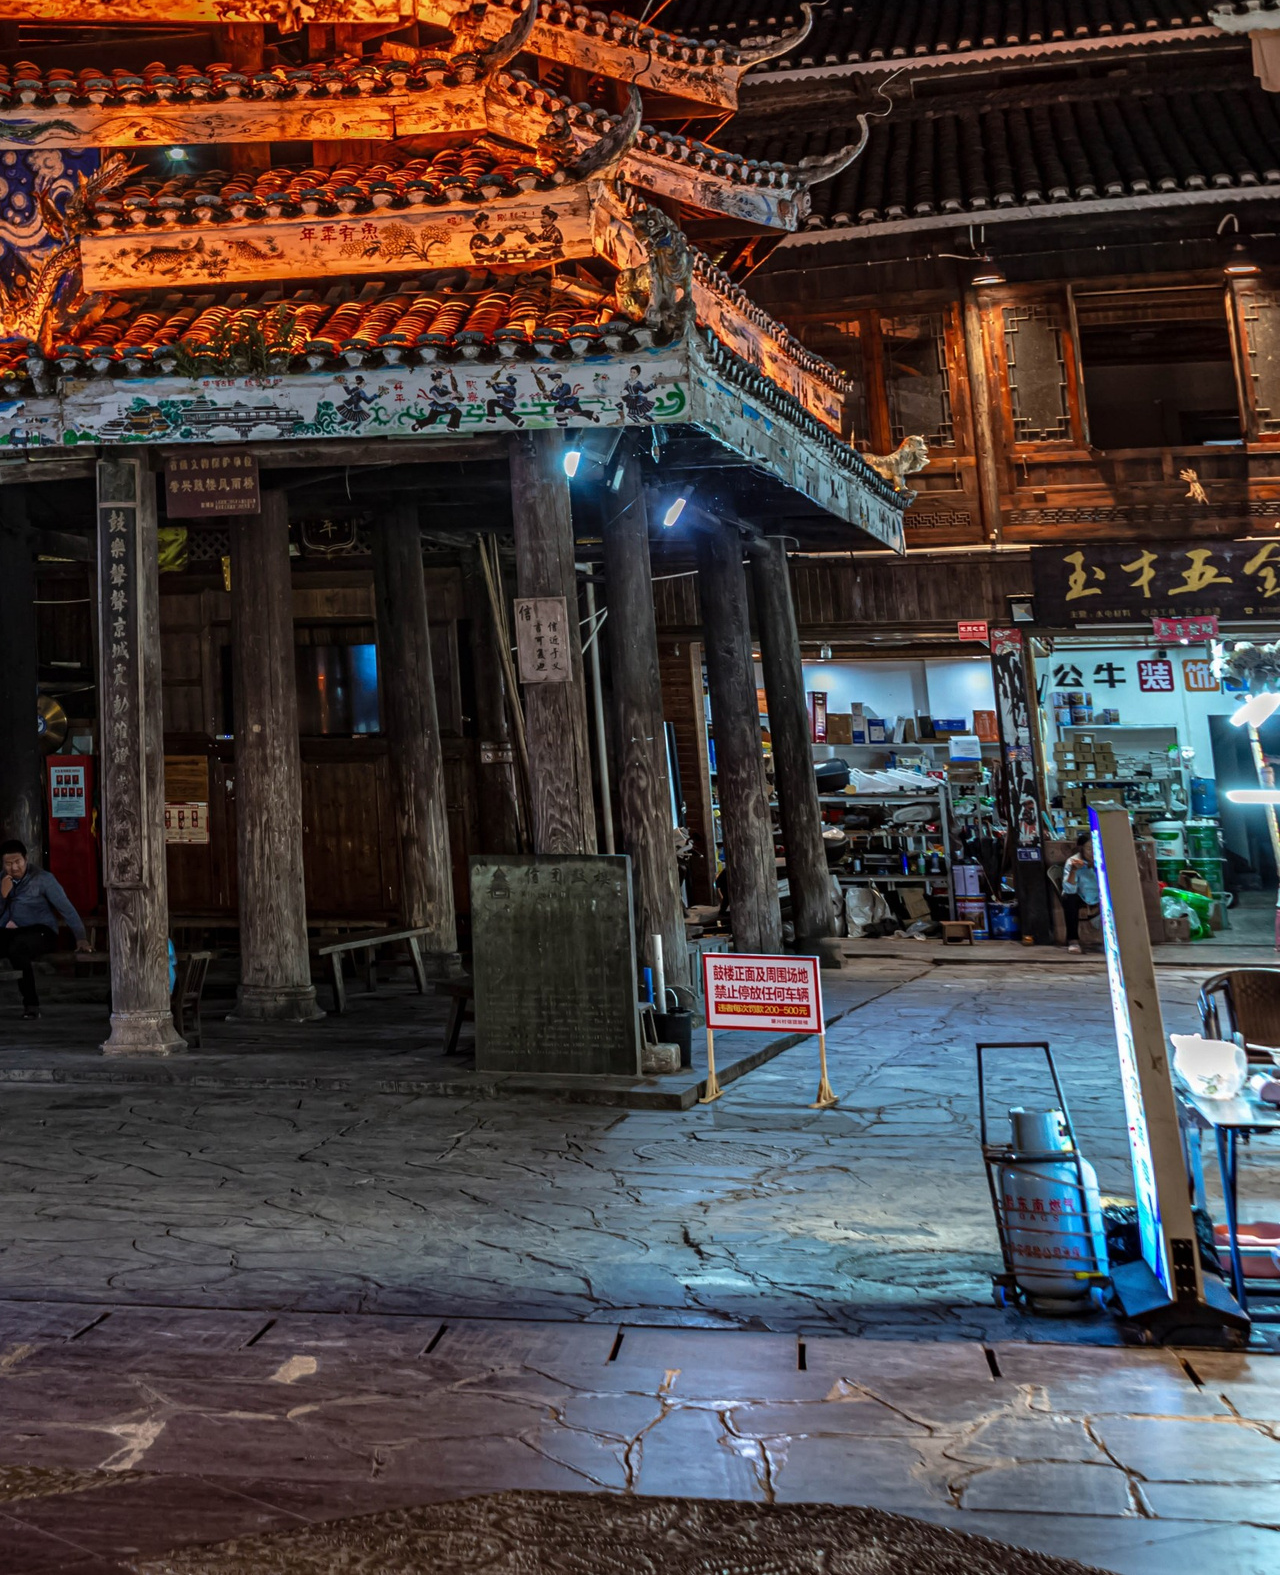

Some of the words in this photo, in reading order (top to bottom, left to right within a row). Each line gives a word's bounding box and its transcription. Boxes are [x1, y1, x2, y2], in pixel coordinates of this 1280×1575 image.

[713, 964, 809, 984] 鼓楼正面及周围场地
[714, 984, 810, 1003] 禁止停放任何车辆
